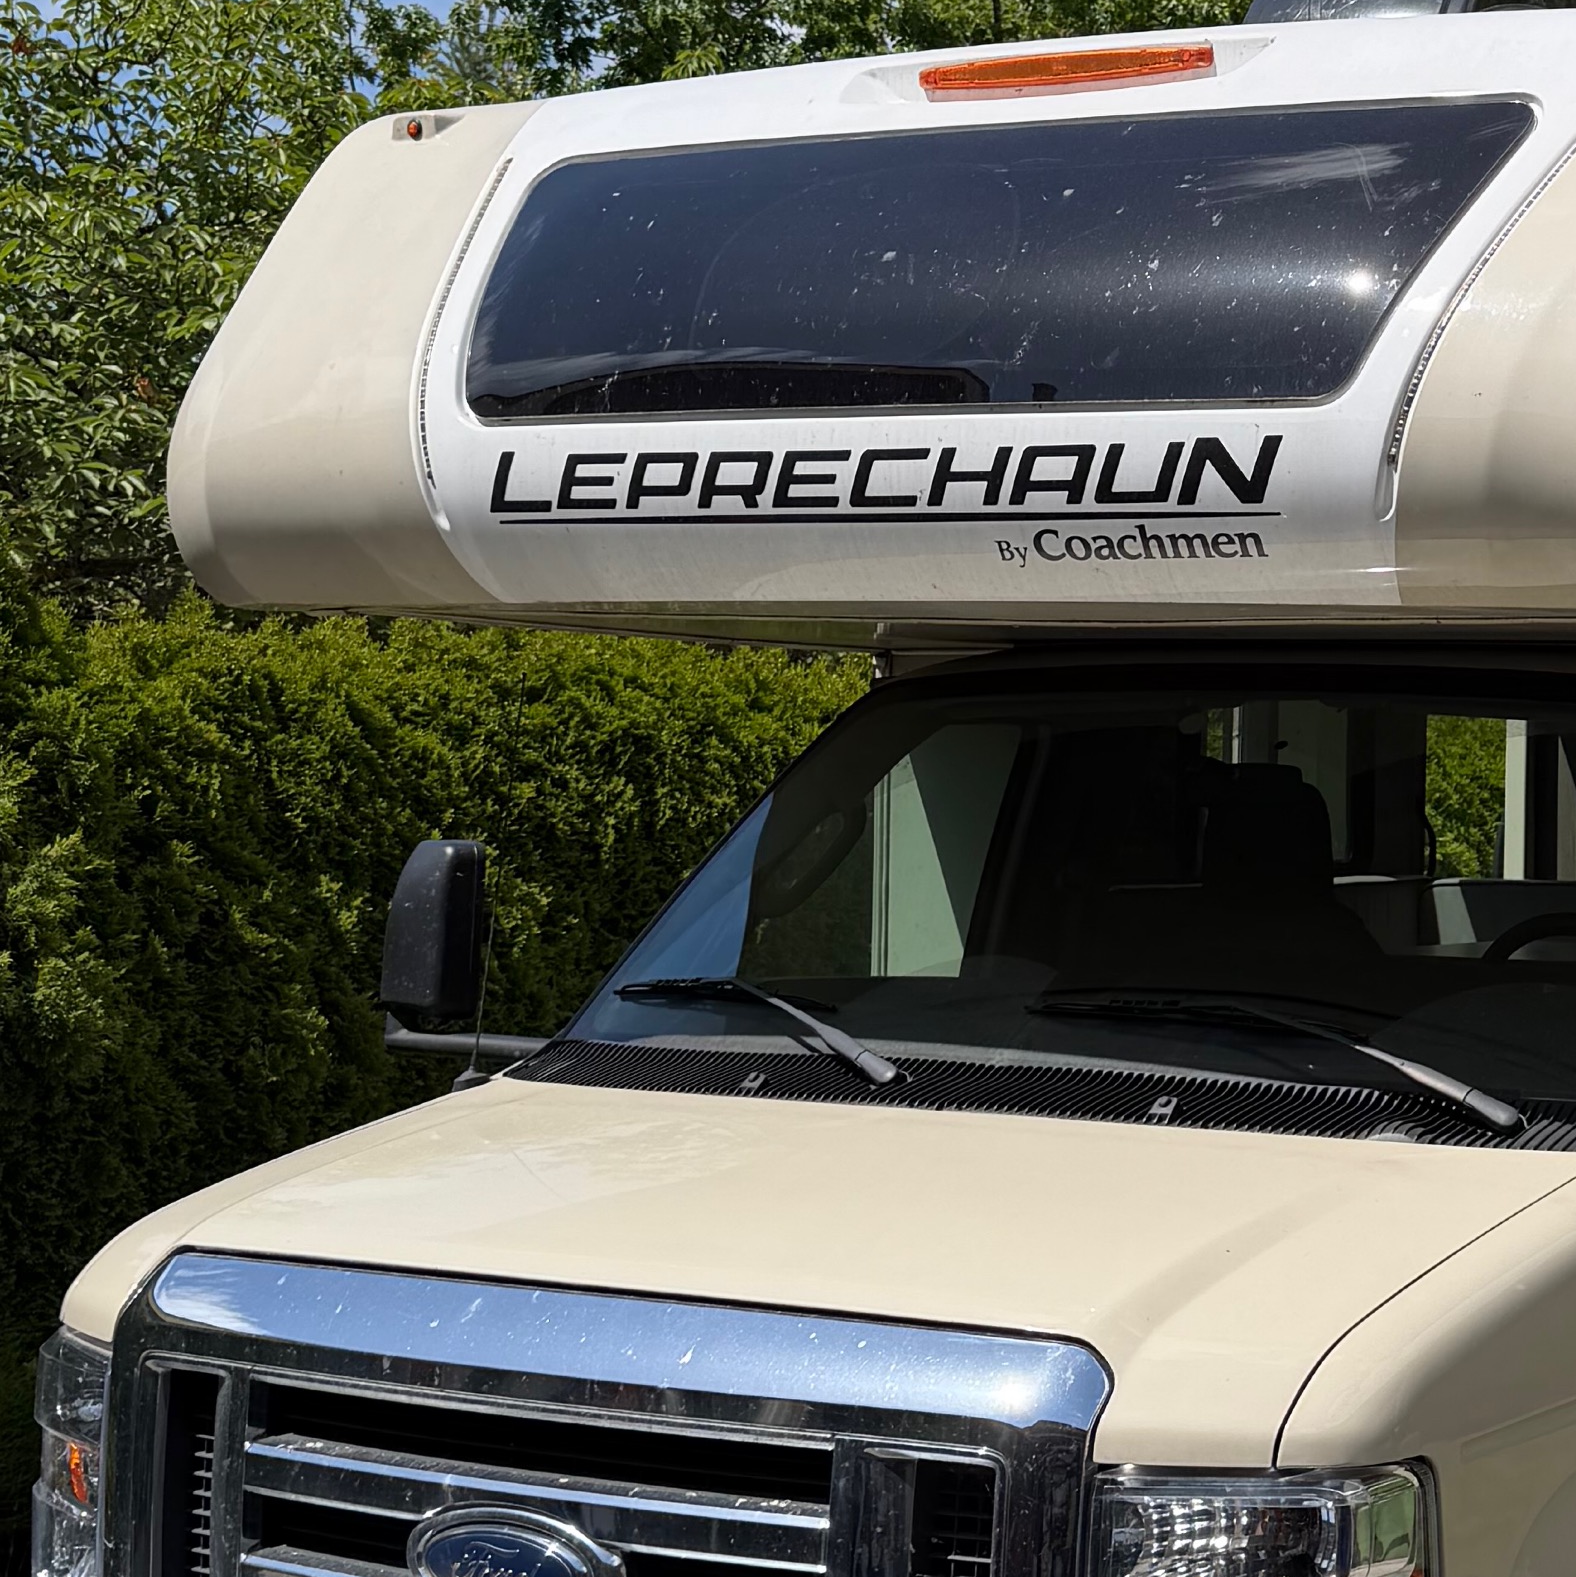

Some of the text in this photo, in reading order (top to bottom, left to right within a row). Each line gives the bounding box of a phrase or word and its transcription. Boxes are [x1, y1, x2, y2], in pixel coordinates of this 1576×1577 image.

[490, 434, 1284, 512] LEPRECHAUN
[994, 523, 1269, 568] By Coachmen
